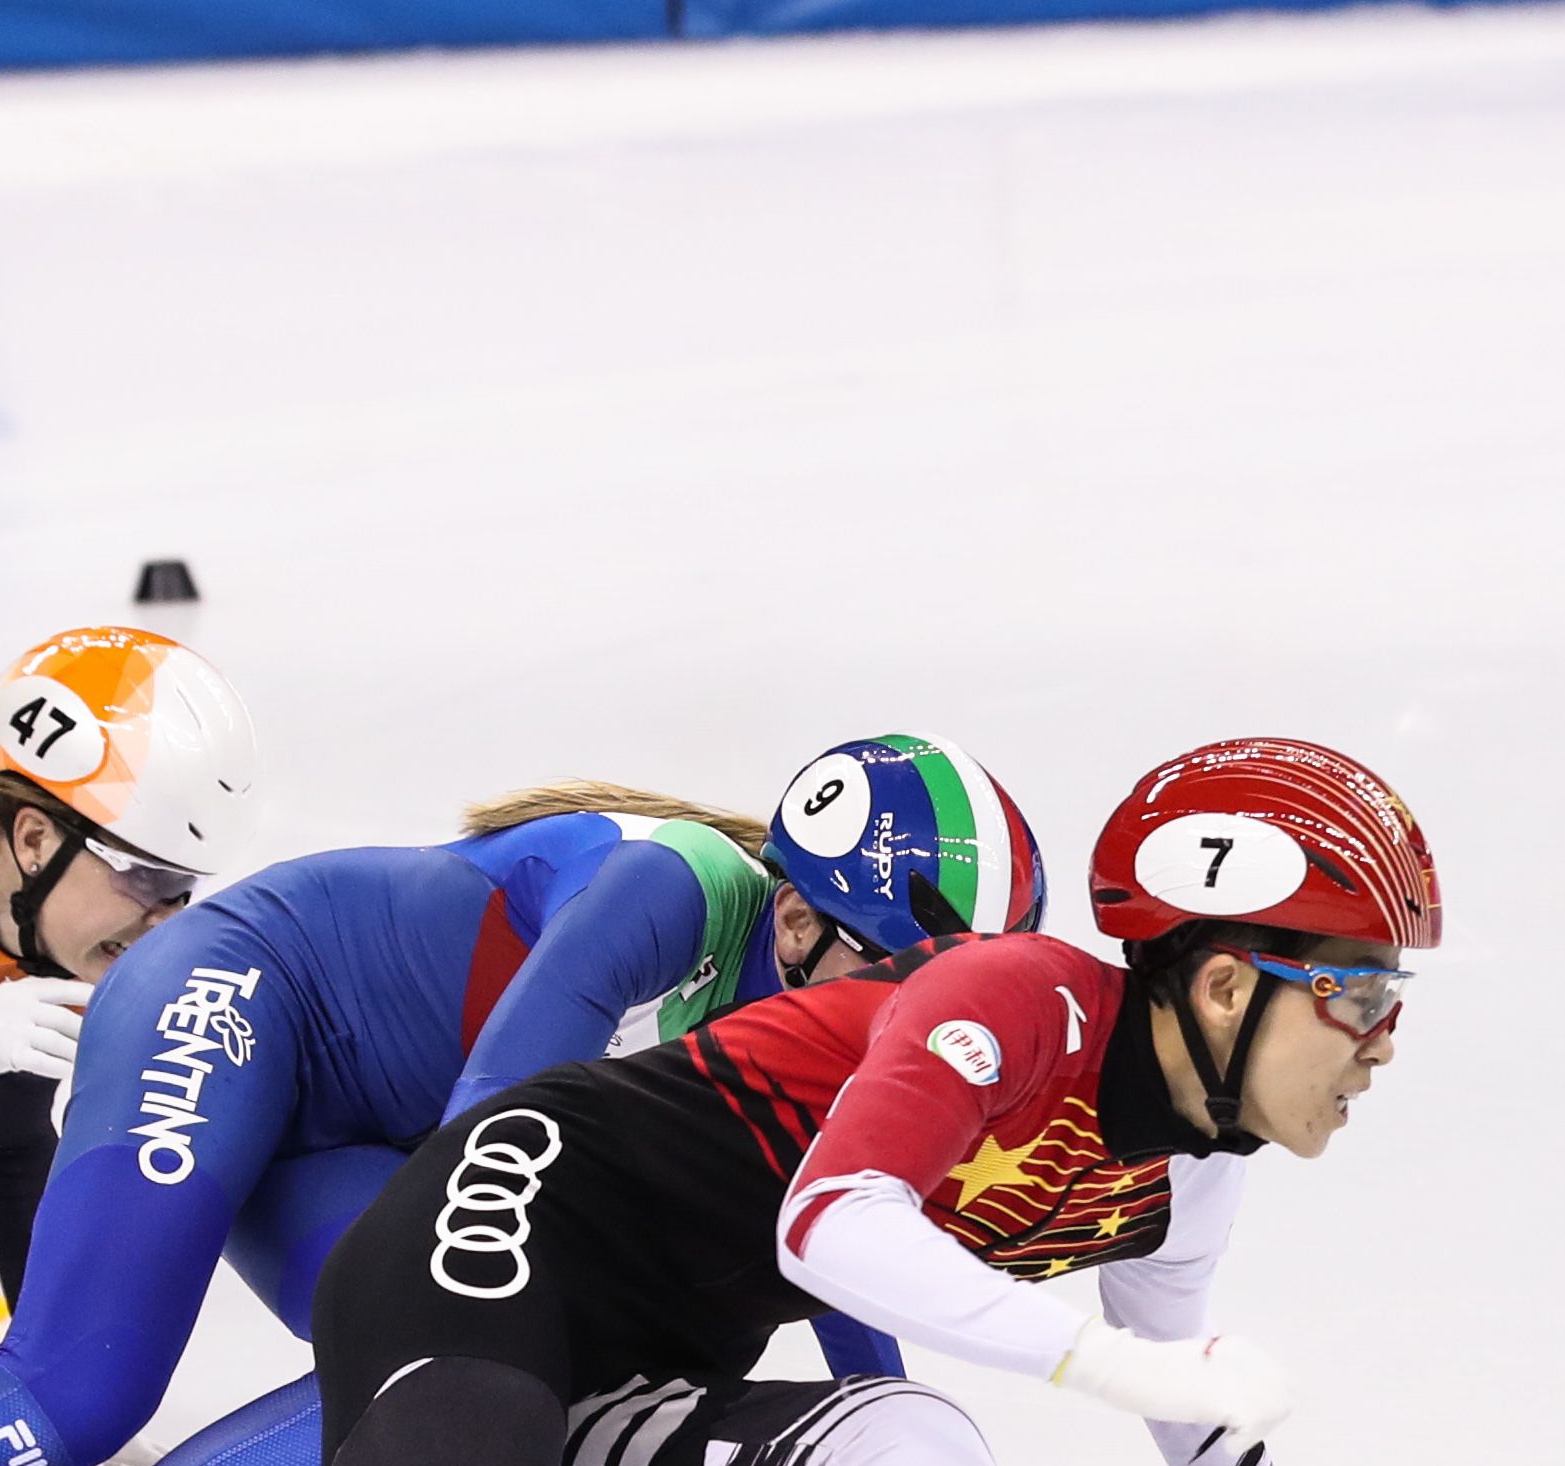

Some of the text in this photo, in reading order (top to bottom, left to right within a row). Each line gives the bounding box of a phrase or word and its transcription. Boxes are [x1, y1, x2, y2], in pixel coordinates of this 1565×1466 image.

[9, 696, 77, 759] 47
[804, 779, 844, 816] 9
[879, 812, 893, 900] RUDY
[1200, 837, 1233, 887] 7
[127, 967, 262, 1185] TRENTINO
[941, 1028, 992, 1073] 伊利
